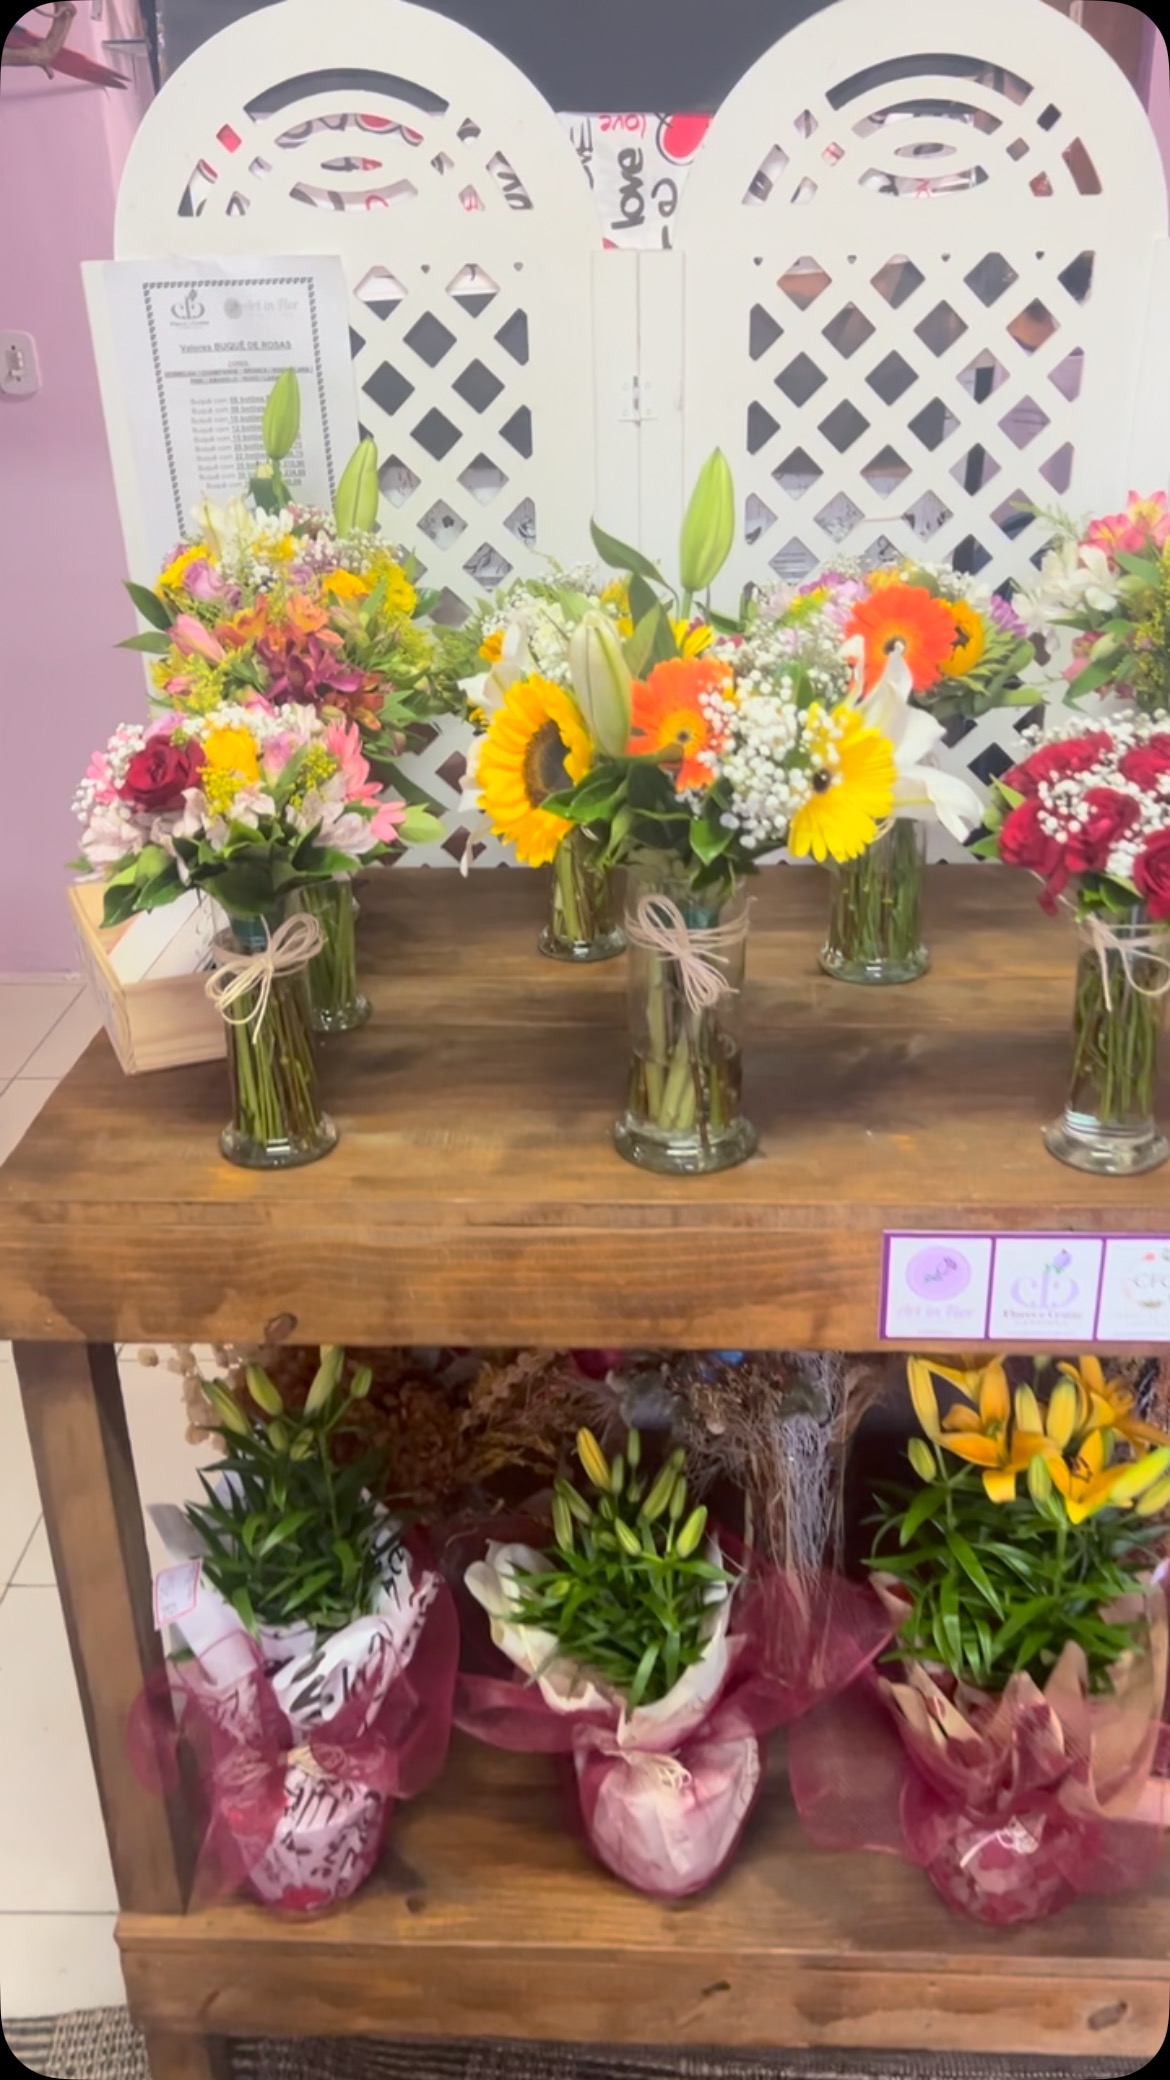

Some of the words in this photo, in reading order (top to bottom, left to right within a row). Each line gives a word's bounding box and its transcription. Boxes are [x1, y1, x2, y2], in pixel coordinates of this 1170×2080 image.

[611, 147, 645, 230] love
[179, 343, 212, 353] Valores
[214, 339, 245, 352] BUQUÊ
[246, 340, 260, 351] DE
[261, 339, 292, 351] ROSAS
